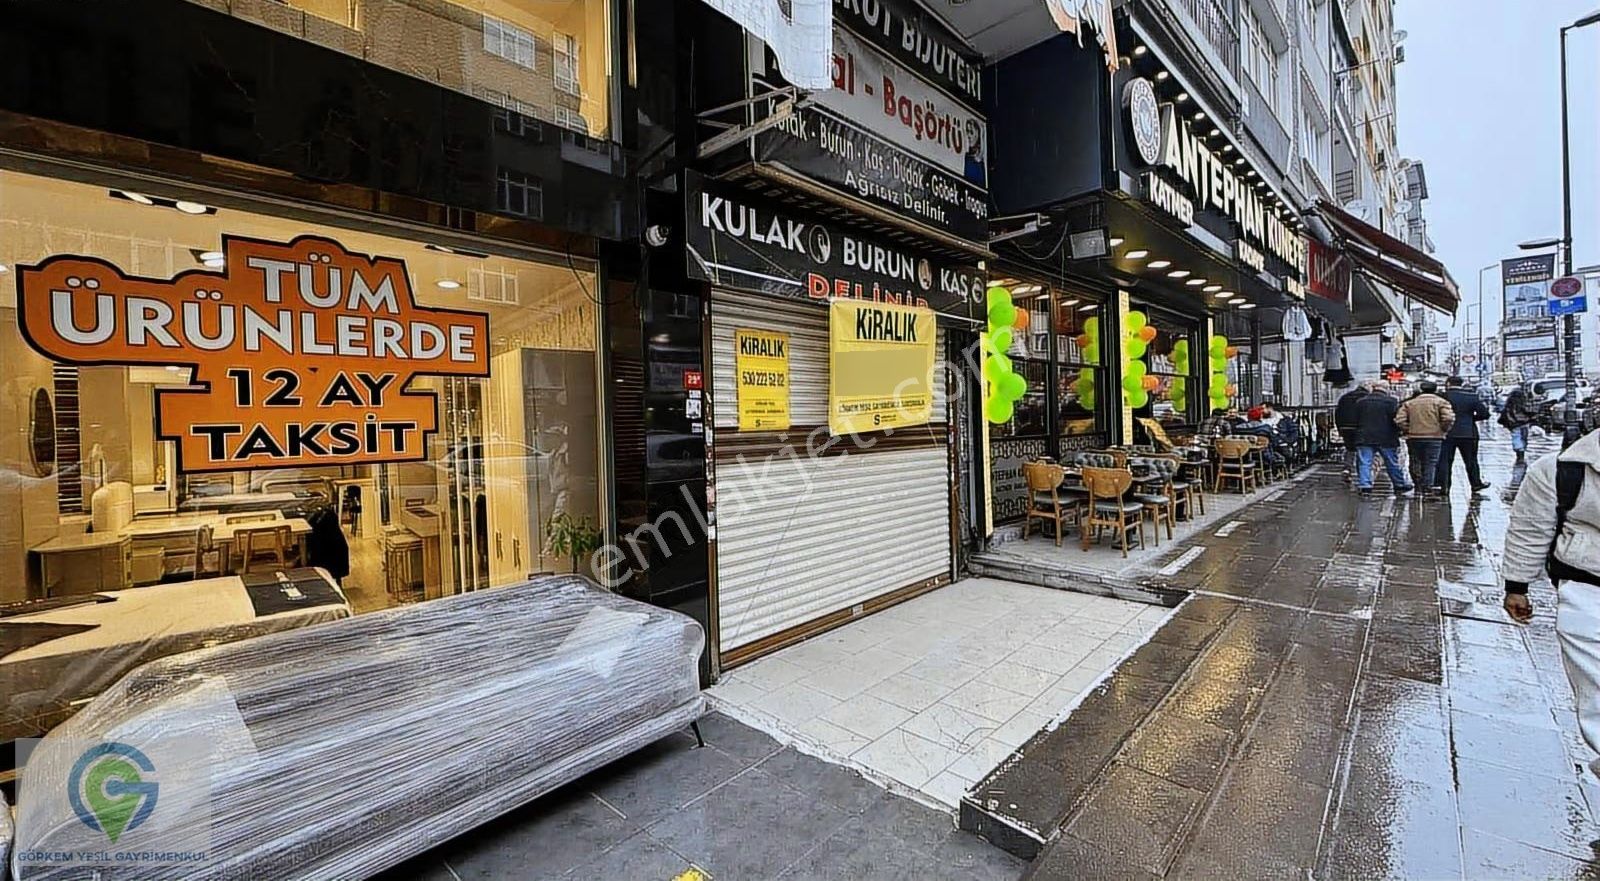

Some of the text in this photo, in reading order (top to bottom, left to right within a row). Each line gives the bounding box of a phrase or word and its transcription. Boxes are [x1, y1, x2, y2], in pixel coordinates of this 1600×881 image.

[820, 122, 855, 162] Burun
[883, 75, 963, 155] Başörtü
[1150, 171, 1195, 227] KATMER
[1165, 103, 1265, 249] ANTEPHAN
[904, 192, 949, 225] Delinir.
[702, 192, 969, 303] KULAK BURUN KAŞ
[247, 251, 400, 315] TÜM
[51, 276, 478, 362] ÜRÜNLERDE
[226, 367, 399, 408] 12 AY
[190, 413, 418, 462] TAKSİT
